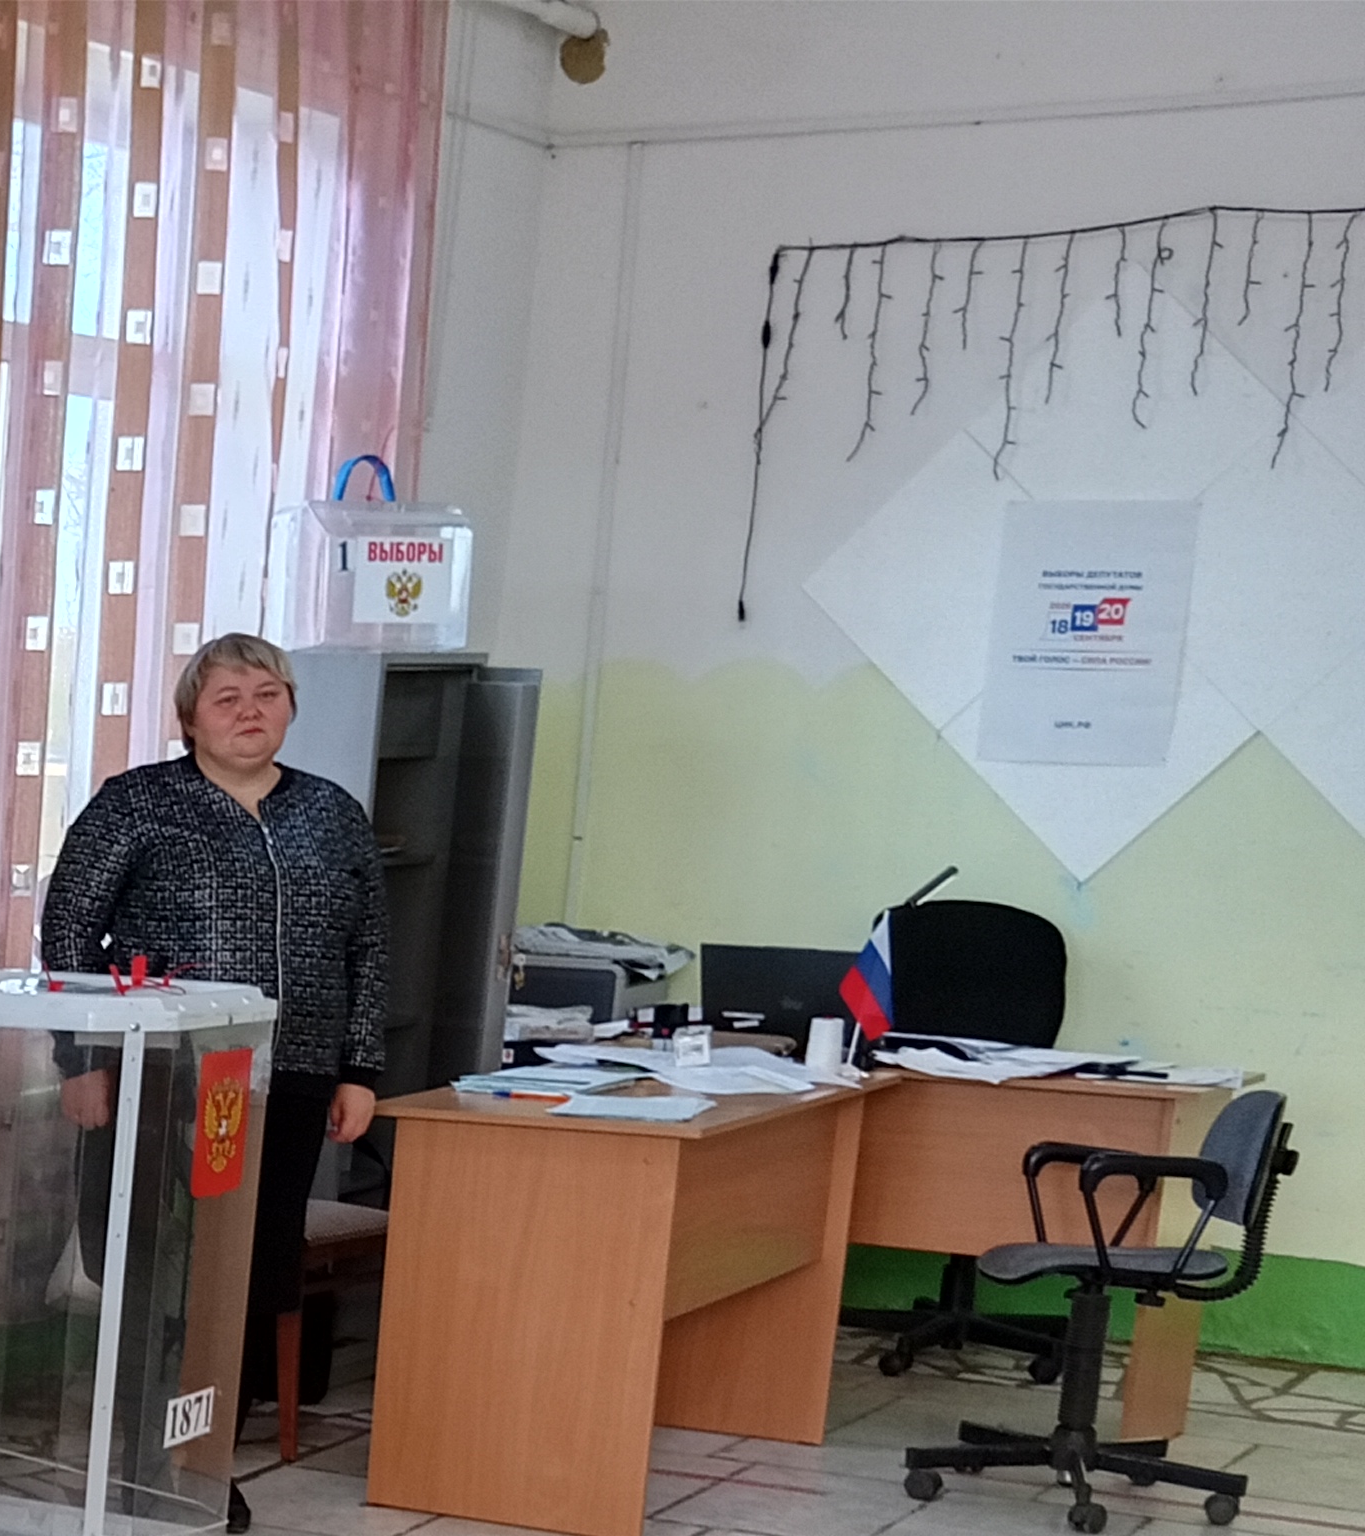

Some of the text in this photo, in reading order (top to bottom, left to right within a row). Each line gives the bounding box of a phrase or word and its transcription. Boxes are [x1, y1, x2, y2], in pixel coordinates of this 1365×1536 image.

[338, 541, 349, 572] 1
[367, 541, 444, 563] ВЫБОРЫ
[1050, 603, 1125, 635] 18 19 20
[169, 1391, 211, 1439] 1871
